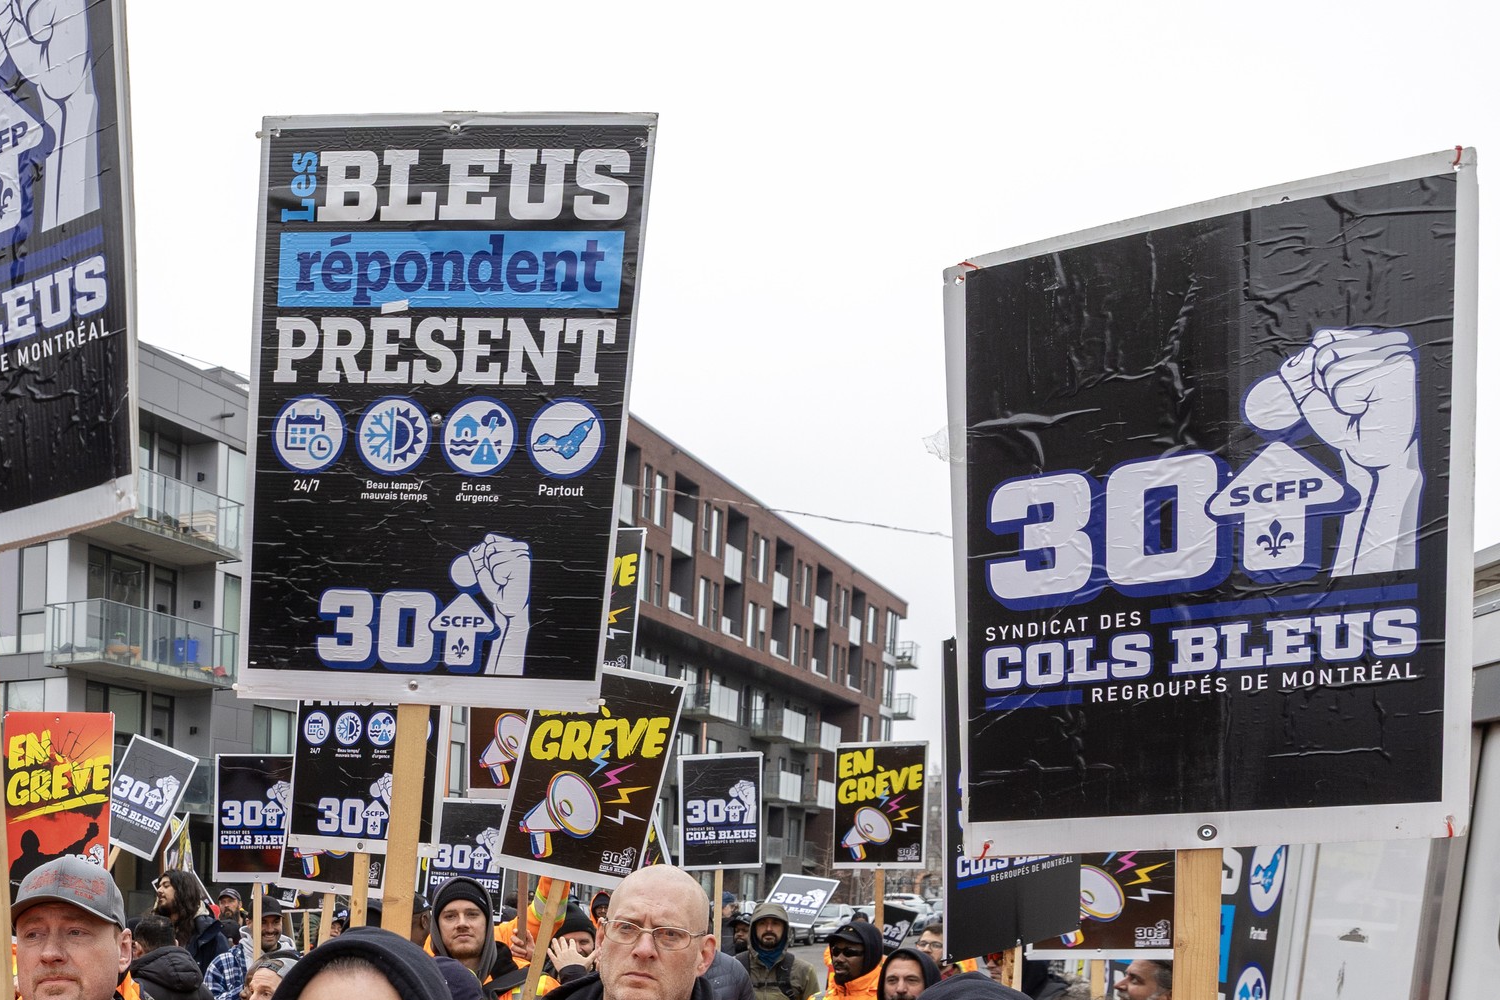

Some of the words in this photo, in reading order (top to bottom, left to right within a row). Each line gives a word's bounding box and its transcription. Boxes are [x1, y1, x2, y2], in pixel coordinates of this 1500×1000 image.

[281, 151, 319, 222] Les
[317, 148, 630, 222] BLEUS
[296, 234, 605, 306] répondent
[17, 320, 109, 367] MONTRÉAL
[273, 300, 618, 386] PRÉSENT
[293, 479, 320, 493] 24/7
[360, 490, 398, 500] mauvais
[400, 491, 428, 502] temps
[366, 480, 389, 490] Beau
[391, 480, 423, 492] temps/
[455, 492, 499, 503] d'urgence
[461, 482, 472, 491] En
[473, 483, 491, 492] cas
[538, 484, 584, 497] Partout
[1229, 478, 1323, 508] SCFP
[439, 614, 485, 629] SCFP
[985, 617, 1089, 642] SYNDICAT
[1100, 610, 1142, 629] DES
[984, 632, 1152, 691] COLS
[1170, 608, 1419, 675] BLEUS
[1092, 673, 1227, 703] REGROUPÉS
[1240, 674, 1269, 693] DE
[1282, 660, 1417, 688] MONTRÉAL
[530, 704, 670, 761] GRÈVE
[8, 729, 52, 771] EN
[309, 747, 321, 755] 24/7
[838, 748, 875, 779] EN
[6, 752, 111, 807] GRÈVE
[838, 764, 923, 805] GRÈVE
[128, 810, 162, 831] BLEUS
[365, 809, 385, 817] SCFP
[220, 834, 252, 845] COLS
[253, 834, 285, 845] BLEU
[686, 830, 716, 841] COLS
[718, 829, 757, 840] BLEUS
[990, 866, 1030, 883] REGROUPÉS
[1031, 864, 1040, 873] DE
[1041, 855, 1074, 871] MONTRÉAL
